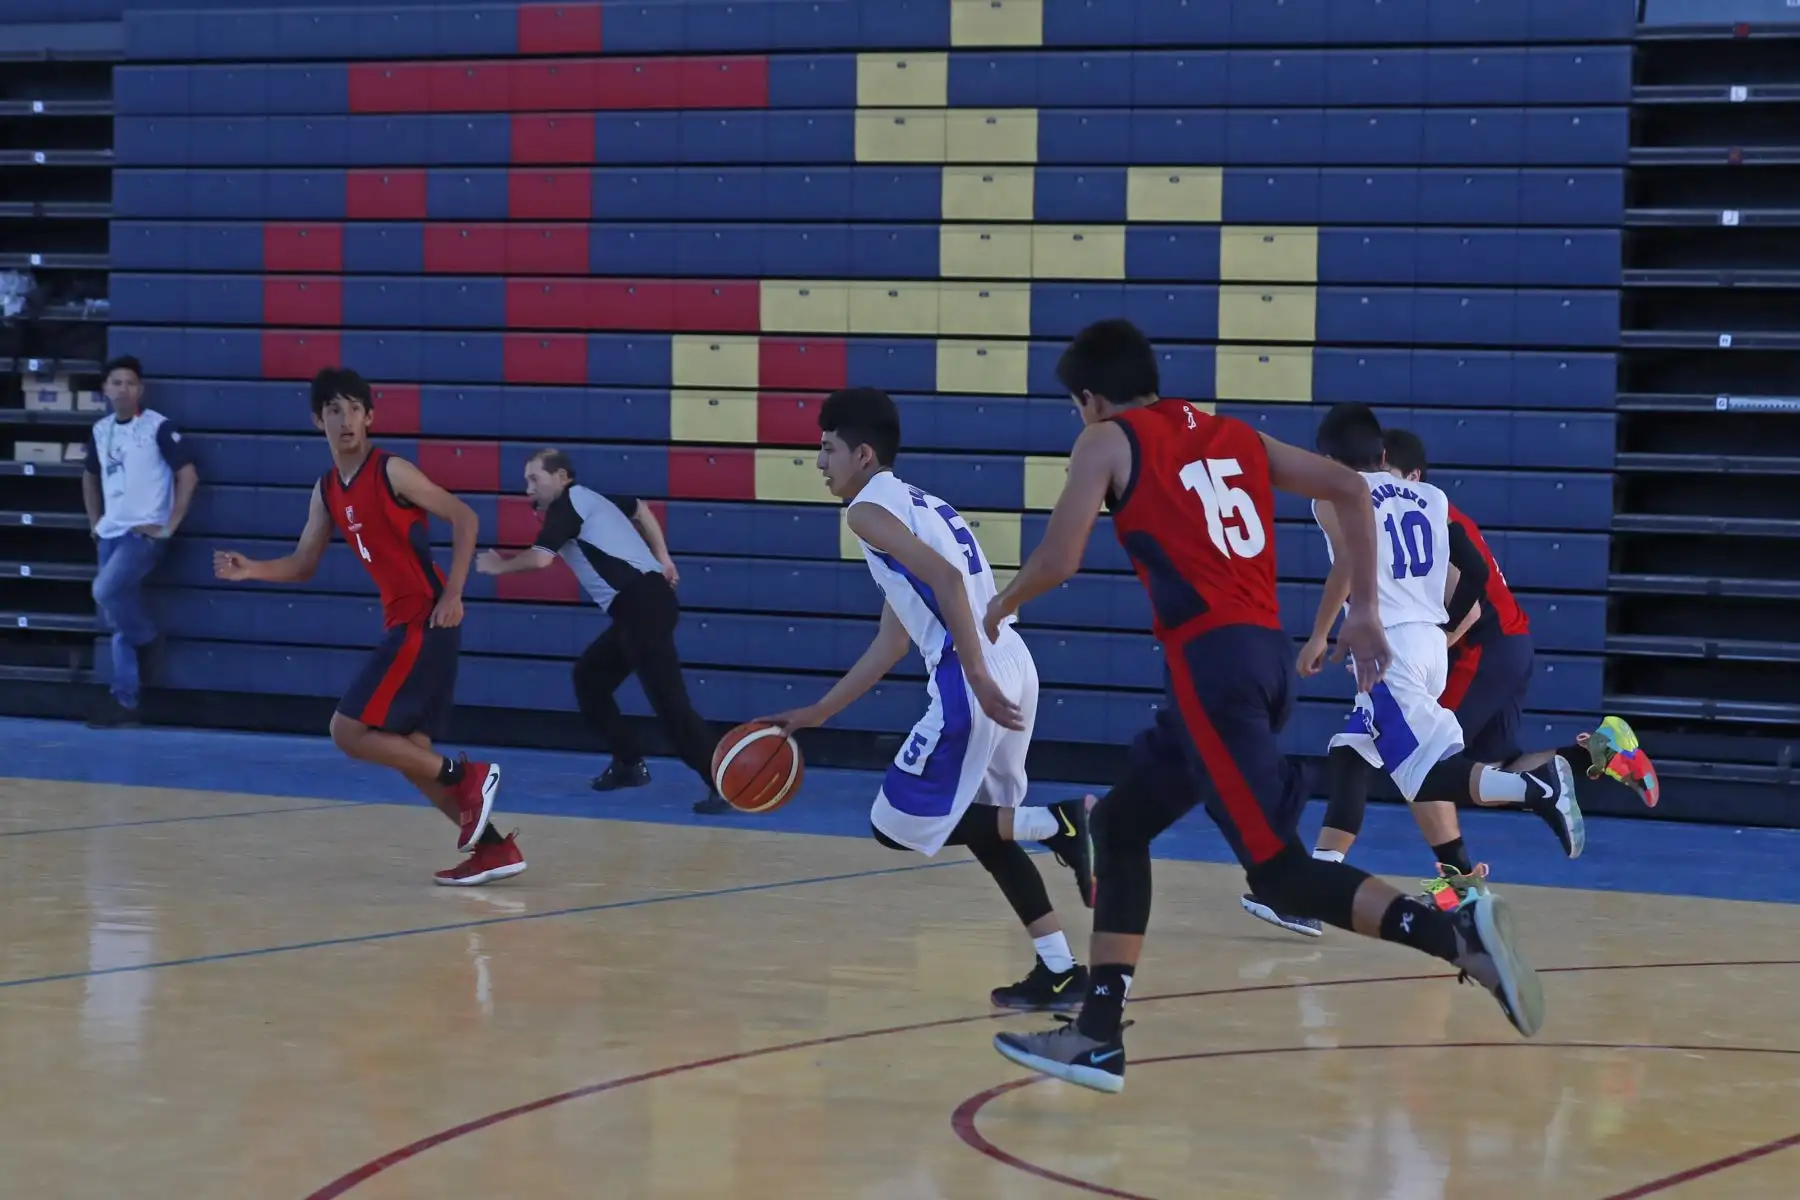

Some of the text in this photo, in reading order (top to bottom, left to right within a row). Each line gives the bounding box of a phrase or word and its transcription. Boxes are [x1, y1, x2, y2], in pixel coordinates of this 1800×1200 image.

[934, 504, 983, 576] 5
[1179, 458, 1266, 561] 15
[355, 532, 372, 563] 4
[1383, 510, 1434, 580] 10
[903, 731, 929, 767] 5
